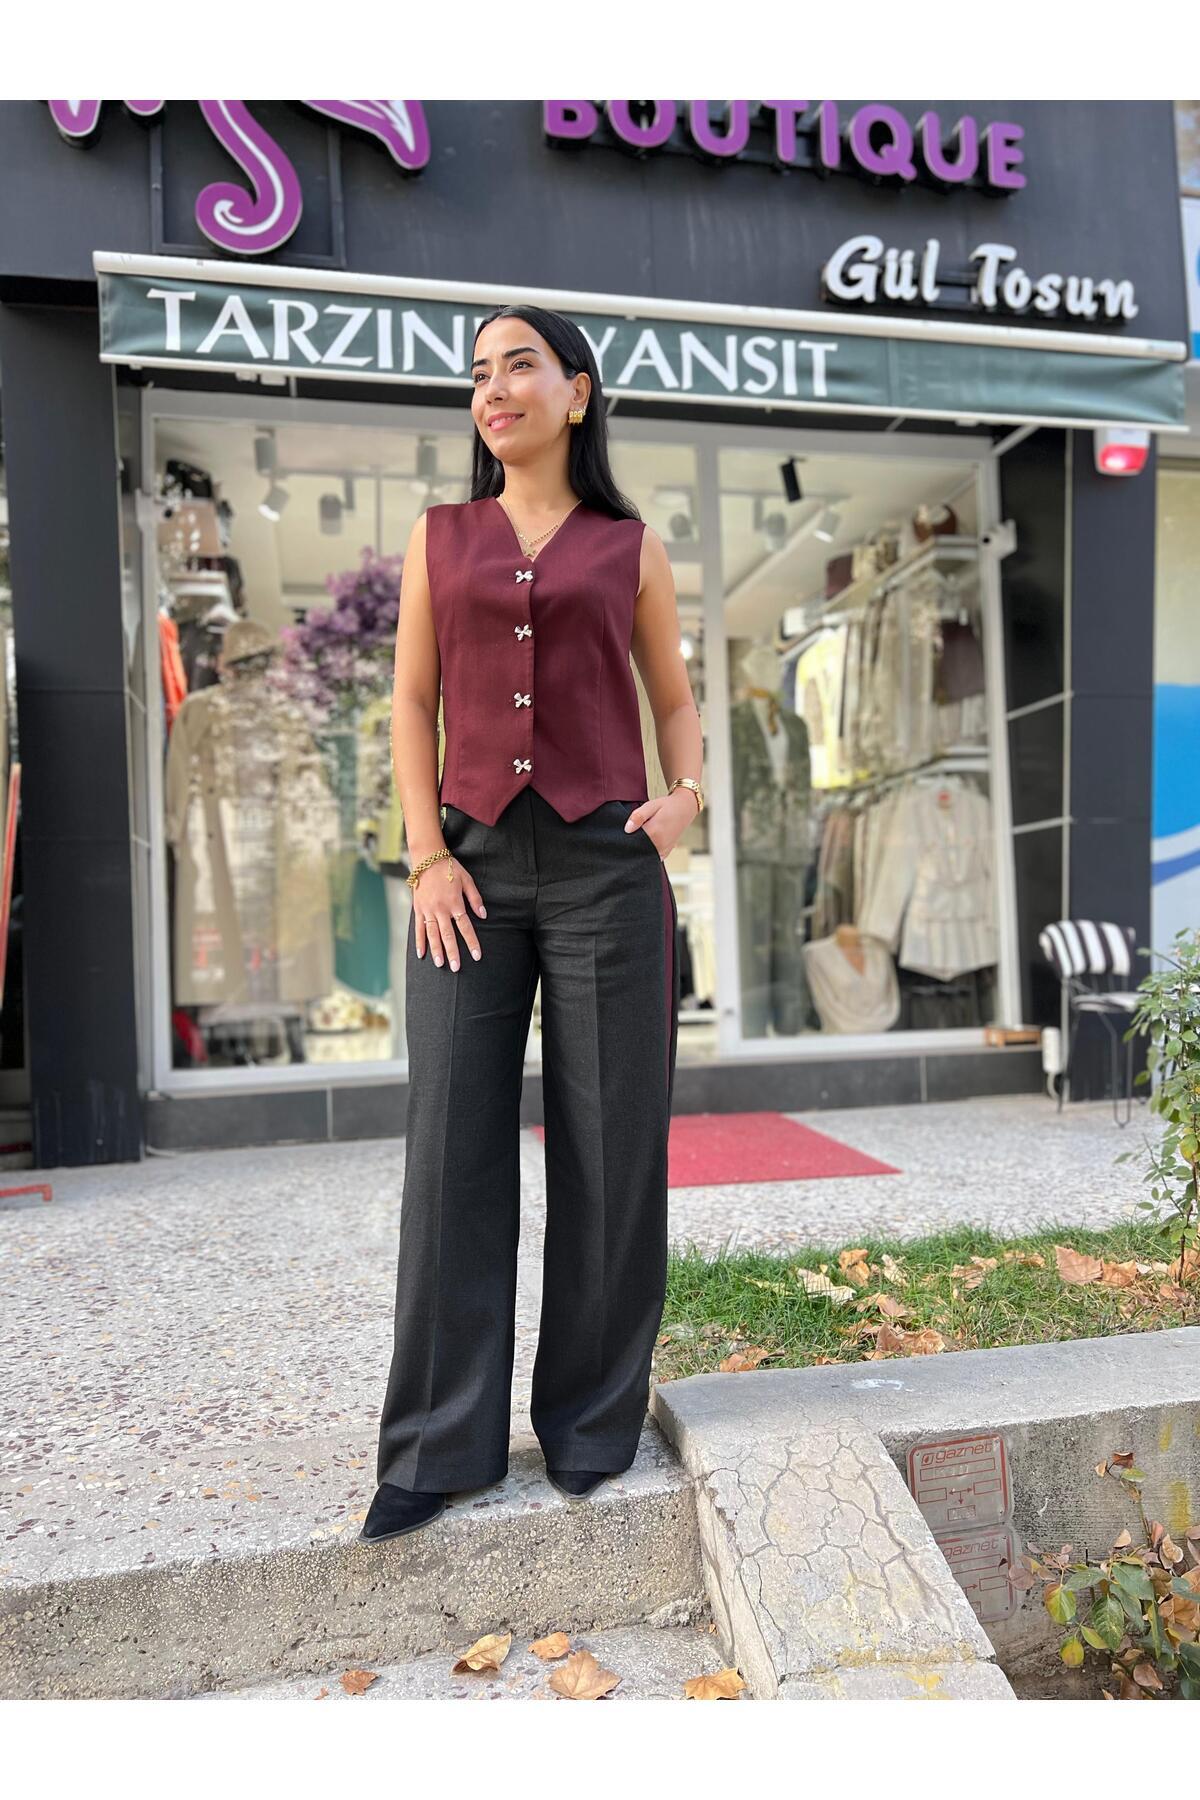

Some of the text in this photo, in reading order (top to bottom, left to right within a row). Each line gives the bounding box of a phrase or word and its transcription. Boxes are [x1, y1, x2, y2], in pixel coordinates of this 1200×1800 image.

[824, 235, 1139, 319] Gül Tosun
[147, 288, 484, 375] TARZIN
[936, 1440, 993, 1463] gaznet
